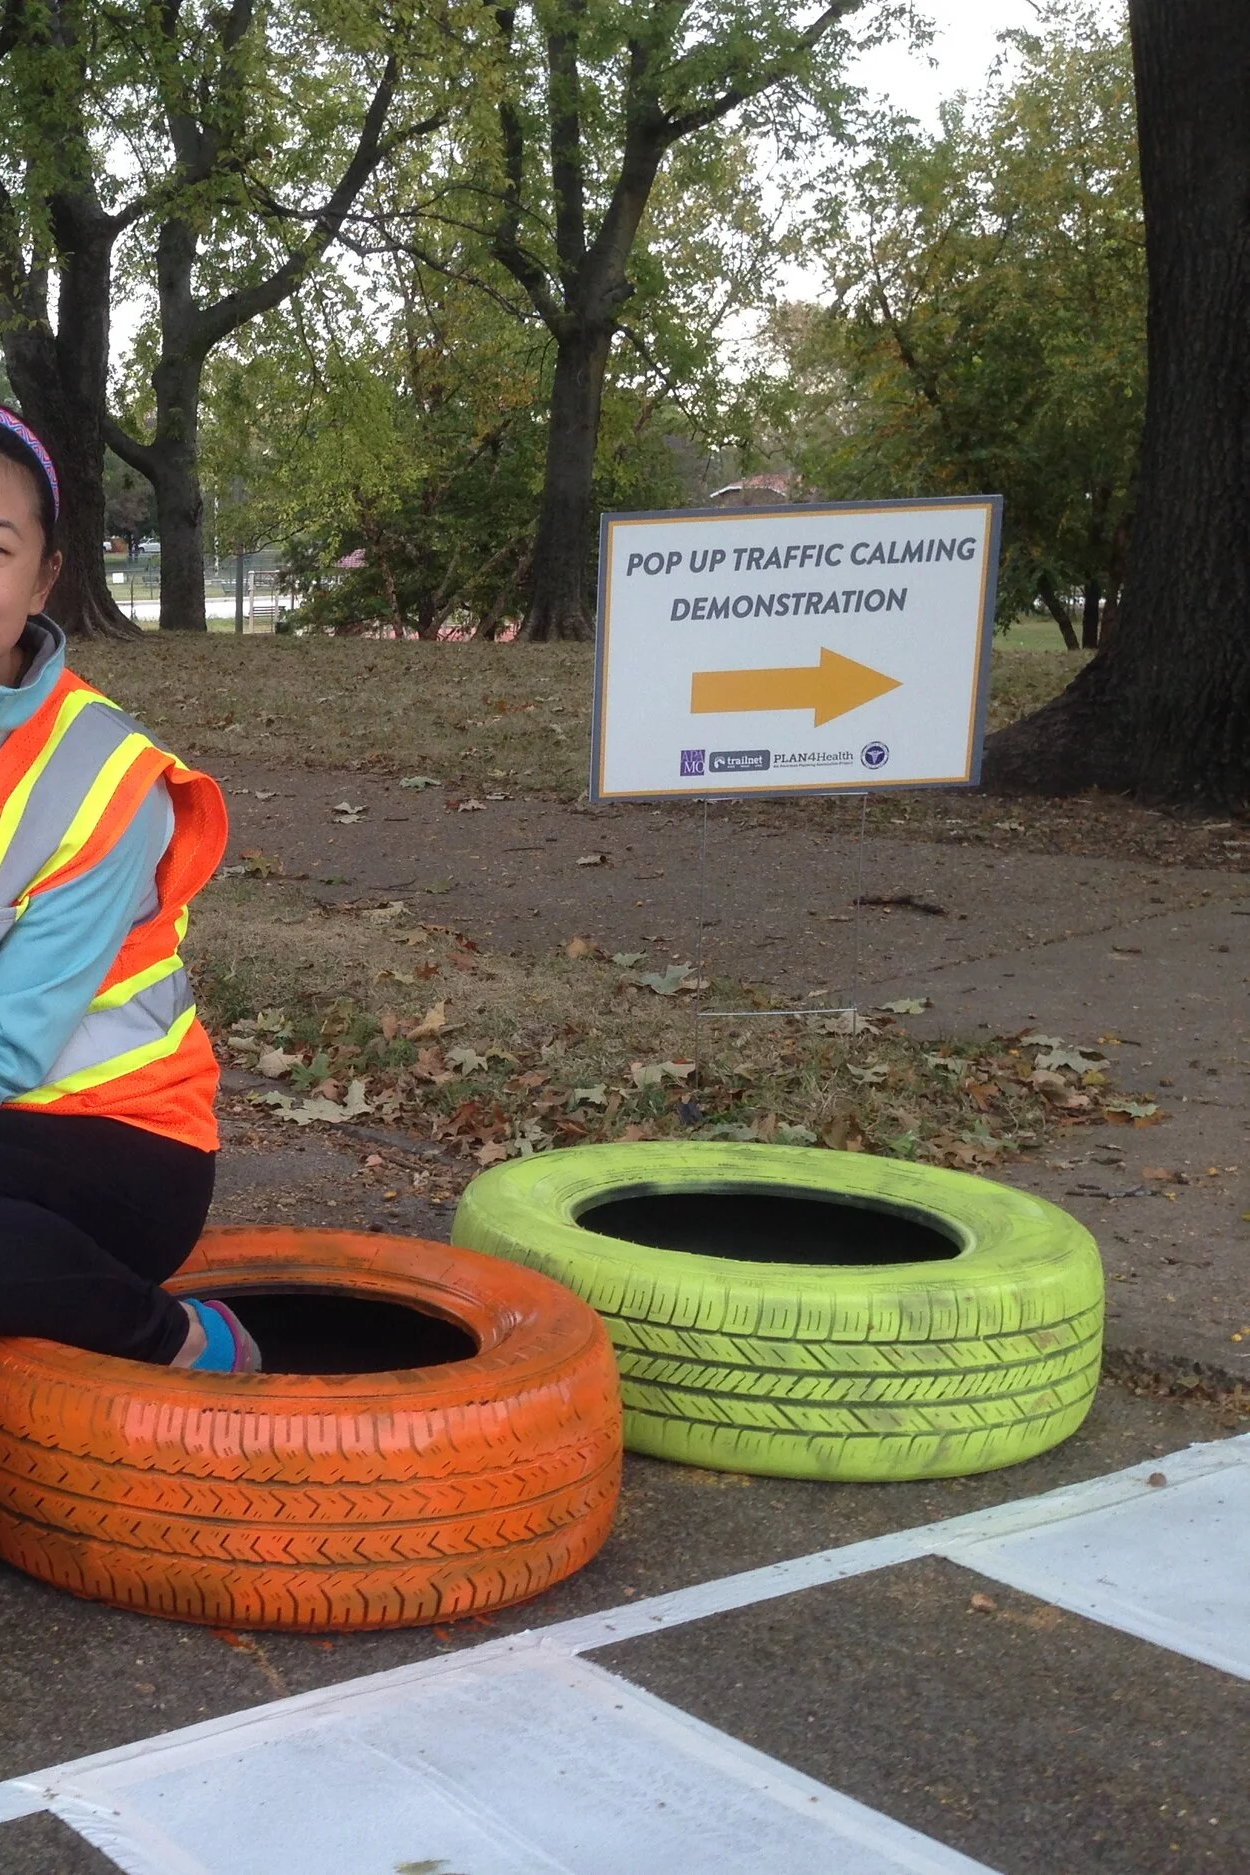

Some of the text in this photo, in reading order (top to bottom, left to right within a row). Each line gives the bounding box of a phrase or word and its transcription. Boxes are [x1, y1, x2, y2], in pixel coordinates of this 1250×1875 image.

[626, 537, 977, 577] POP UP TRAFFIC CALMING
[670, 588, 908, 622] DEMONSTRATION
[682, 751, 704, 762] APA
[727, 755, 763, 765] trailnet
[773, 751, 854, 764] PLAN4Health
[683, 761, 705, 774] MO
